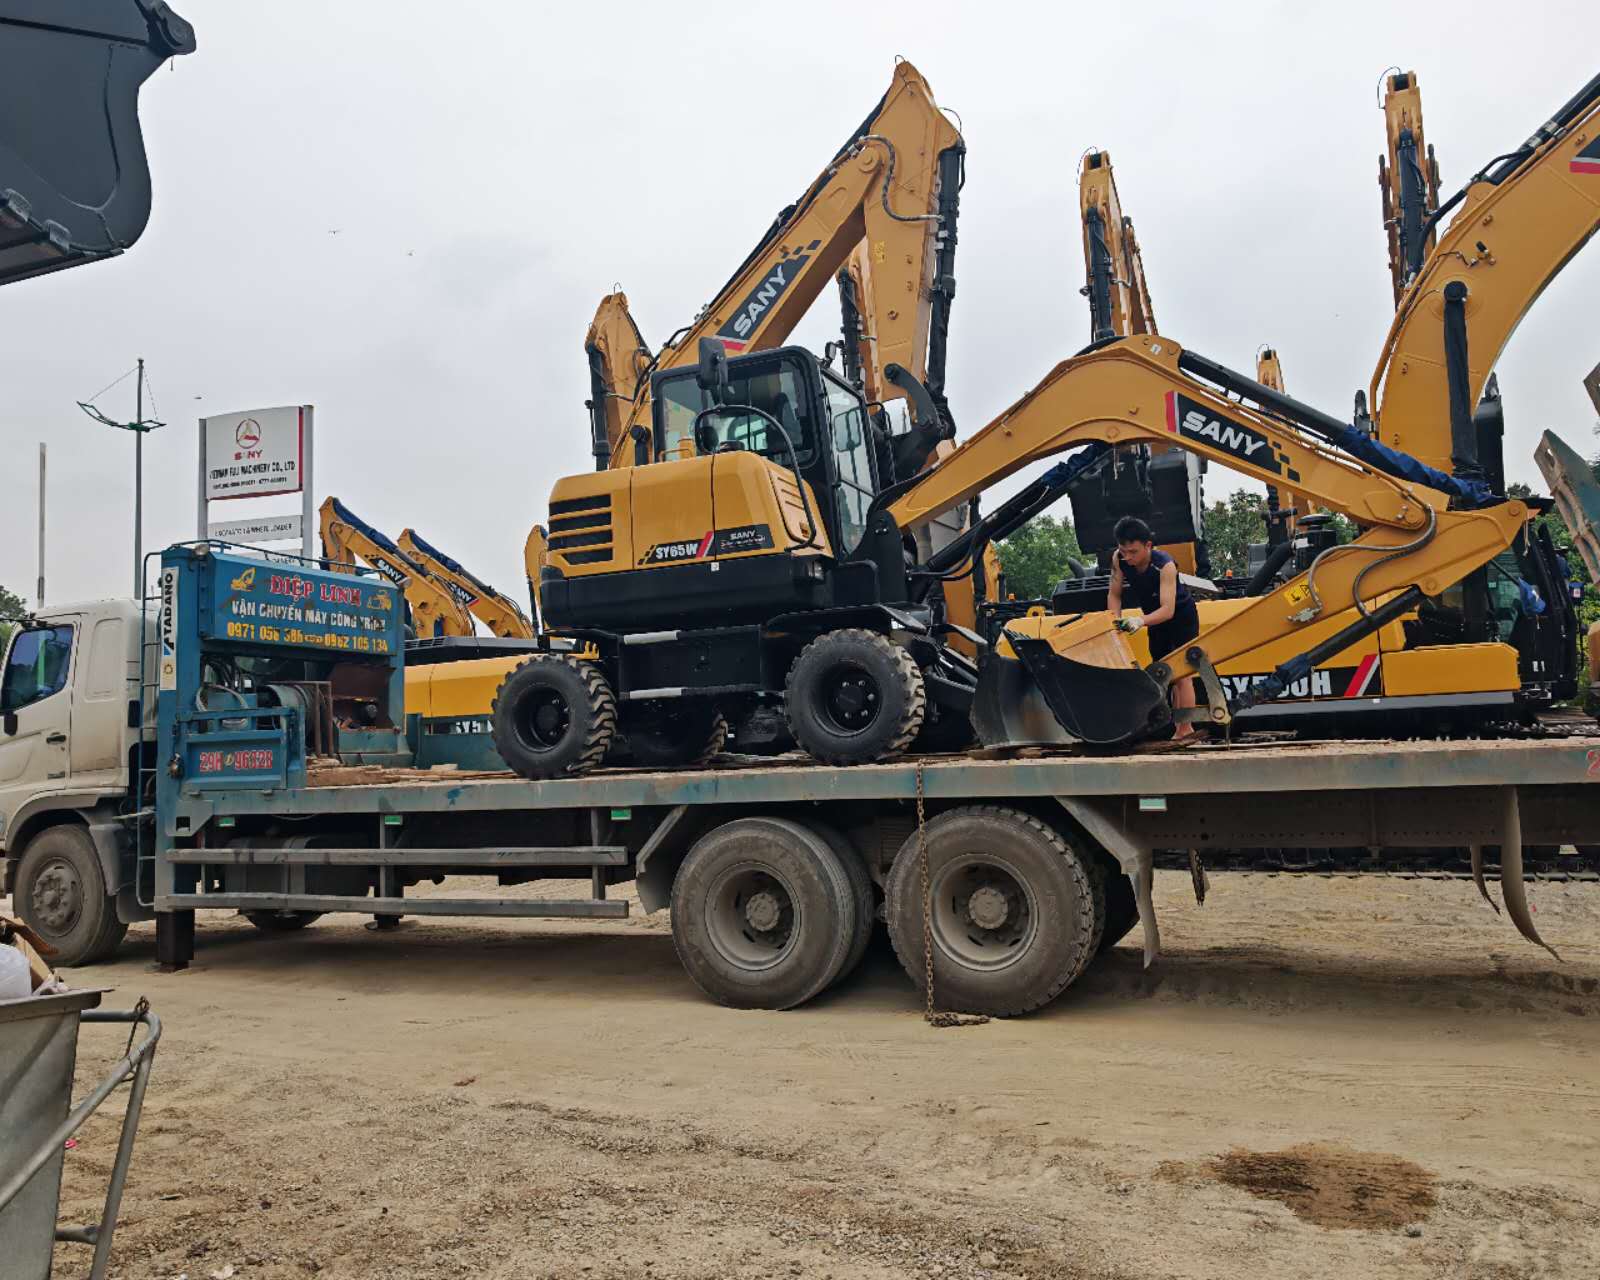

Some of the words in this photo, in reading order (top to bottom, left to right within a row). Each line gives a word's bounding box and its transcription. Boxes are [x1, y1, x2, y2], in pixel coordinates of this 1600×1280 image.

[733, 264, 786, 337] SANY
[1182, 410, 1266, 456] SANY
[234, 449, 263, 461] SNY
[730, 530, 756, 541] SANY
[655, 543, 699, 560] SY65W
[377, 559, 402, 582] SANY
[163, 573, 174, 637] TADANO
[269, 574, 315, 602] ĐIỆP
[319, 582, 362, 607] LINH
[231, 598, 256, 619] VẬN
[304, 606, 328, 626] MÁY
[330, 610, 358, 629] CÔNG
[227, 621, 256, 640] 0971
[1219, 670, 1332, 701] SY0H
